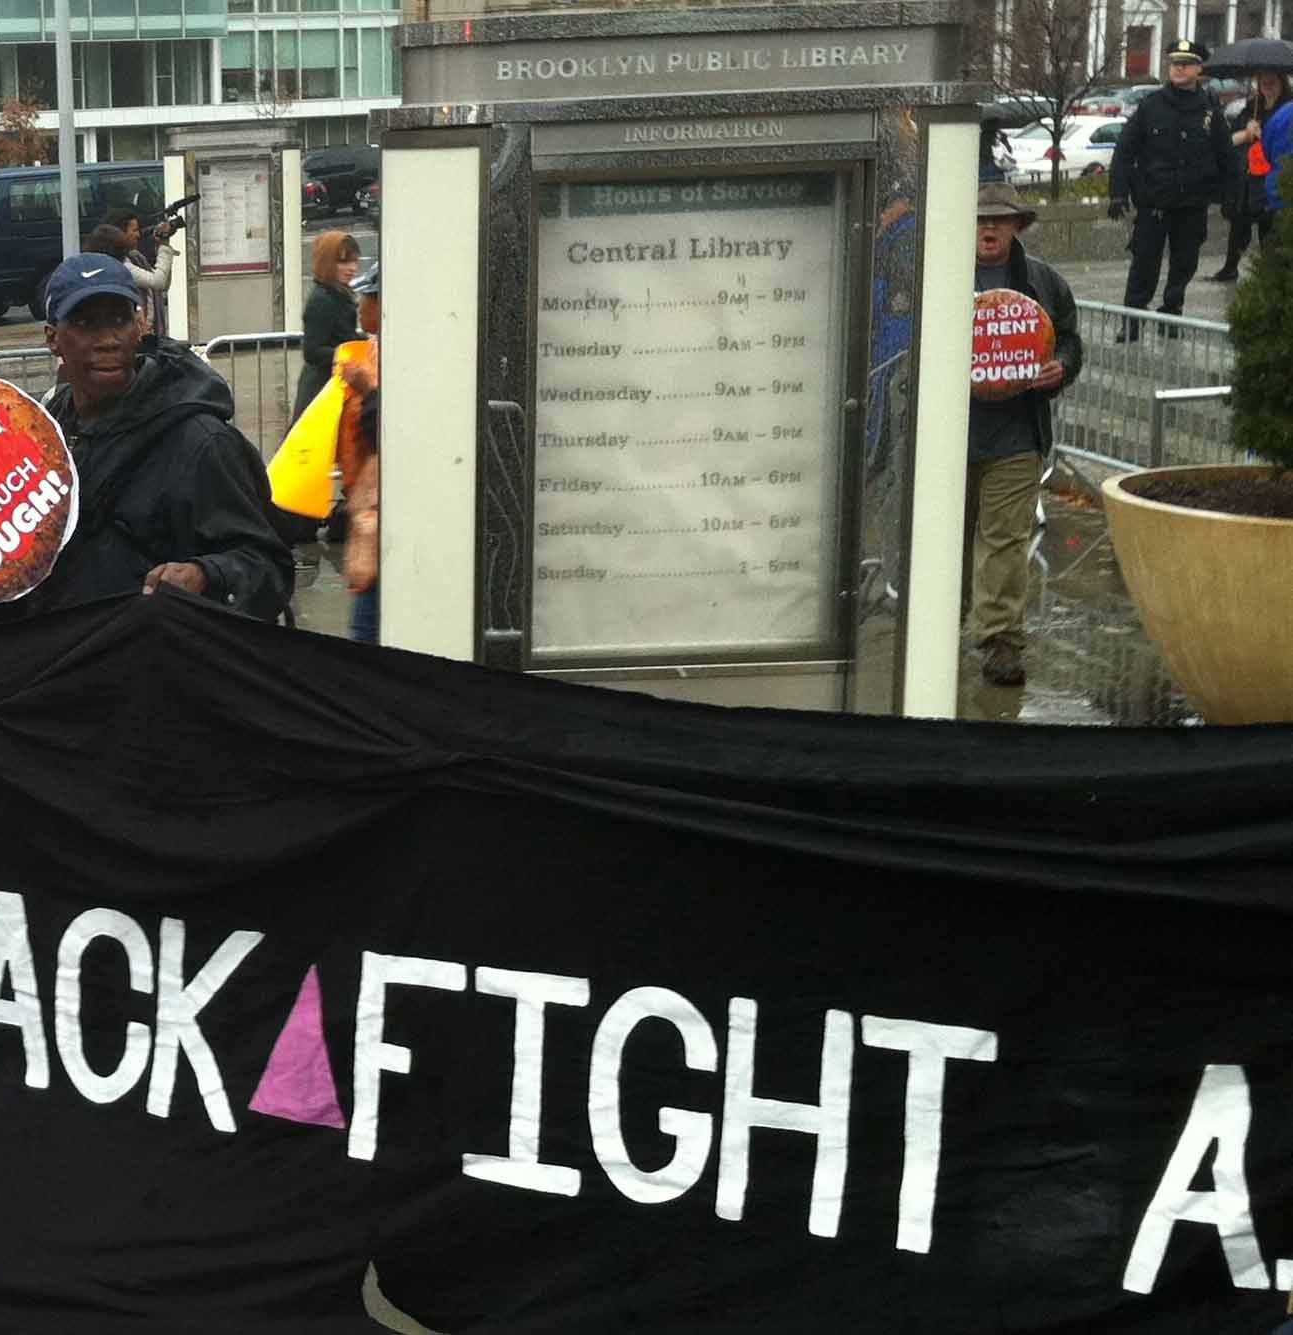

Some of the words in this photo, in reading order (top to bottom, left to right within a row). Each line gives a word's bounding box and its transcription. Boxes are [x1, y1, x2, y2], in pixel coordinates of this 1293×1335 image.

[495, 54, 657, 82] BROOKLYN
[666, 47, 773, 73] PUBLIC
[781, 43, 909, 69] LIBRARY
[624, 119, 786, 144] INFORMATION
[593, 185, 673, 206] Hours
[681, 182, 705, 203] of
[711, 180, 804, 201] Service
[567, 238, 678, 265] Central
[689, 236, 794, 261] Library
[973, 308, 995, 320] ER
[997, 303, 1038, 319] 30%
[987, 318, 1040, 336] RENT
[971, 353, 990, 364] OO
[992, 349, 1035, 364] MUCH
[970, 363, 1041, 382] OUGH!
[348, 951, 997, 1253] FIGHT
[1123, 1064, 1293, 1294] A
